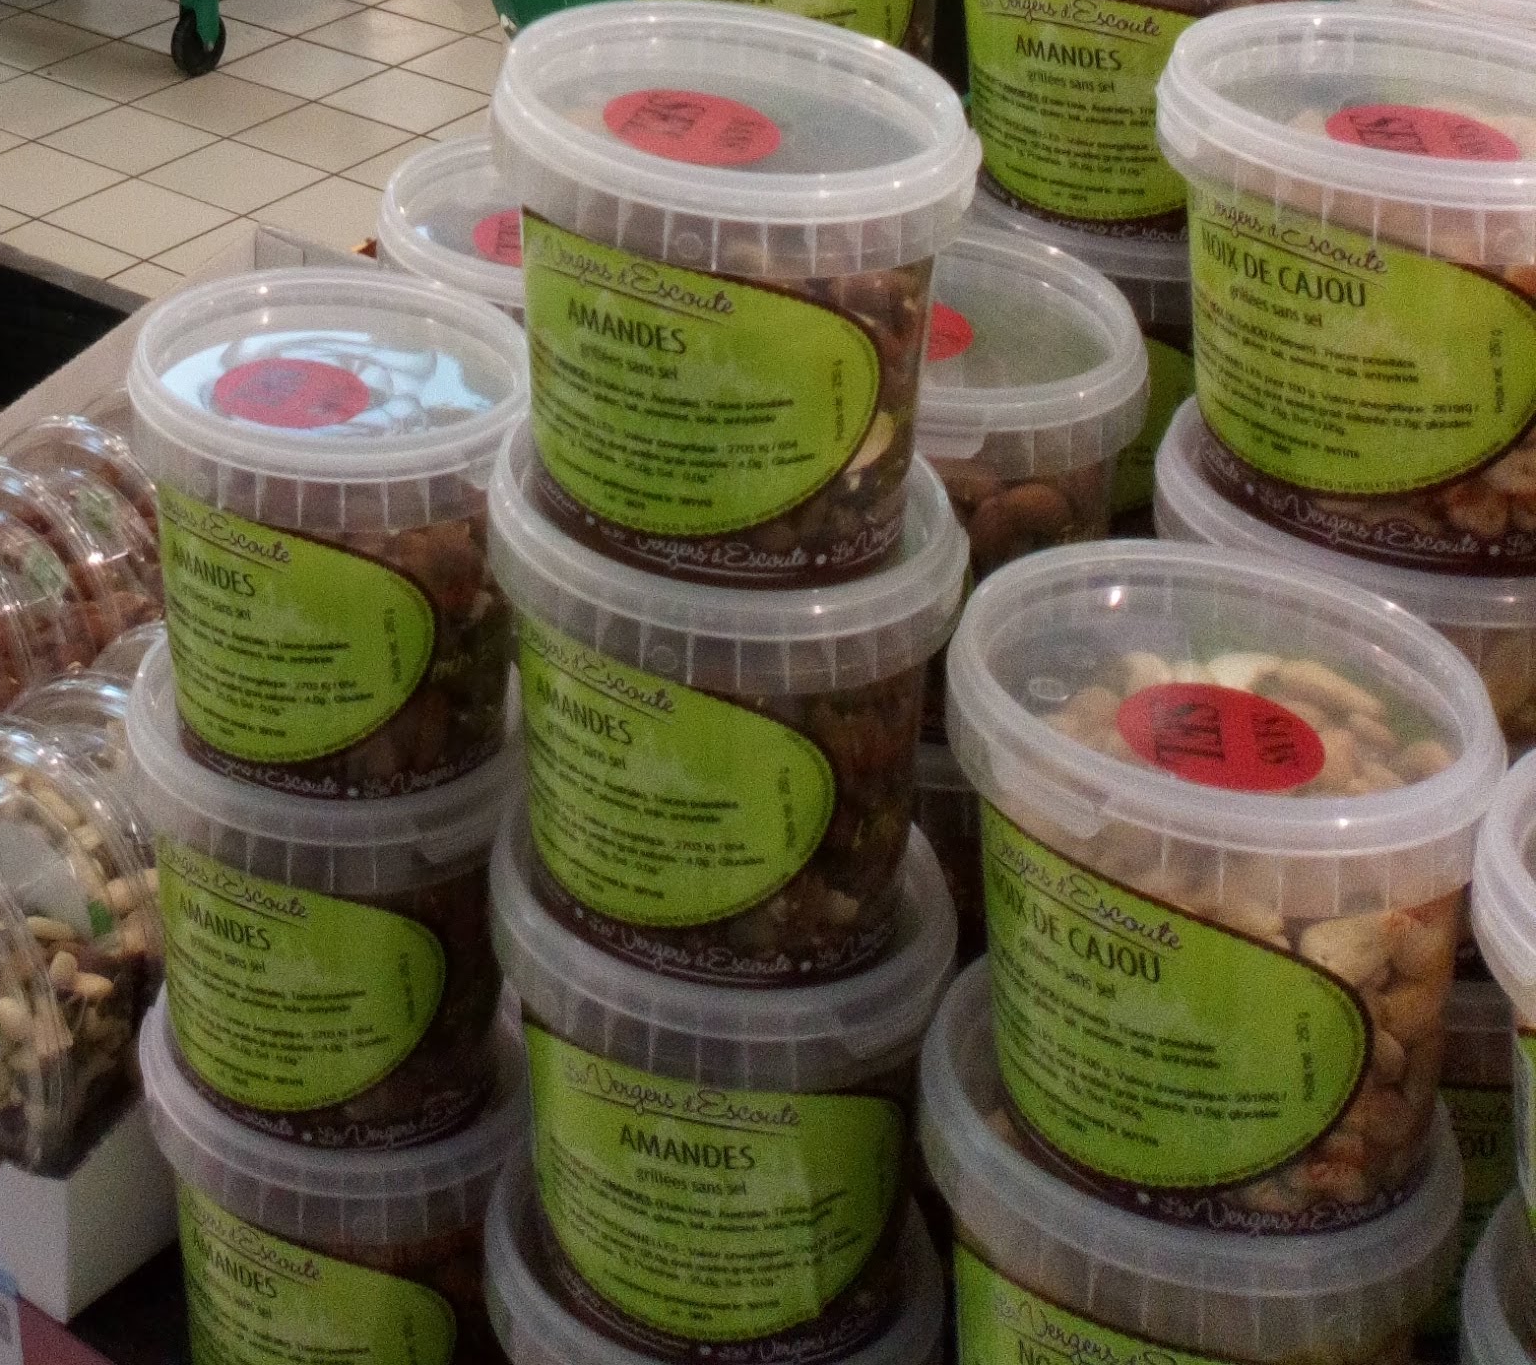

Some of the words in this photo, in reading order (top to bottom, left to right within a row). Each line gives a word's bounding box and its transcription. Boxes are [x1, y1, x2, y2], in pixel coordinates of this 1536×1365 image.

[1015, 33, 1123, 71] AMANDES
[1069, 74, 1094, 91] sans
[1097, 78, 1116, 93] sel
[1202, 224, 1239, 274] NOIX
[1243, 255, 1270, 287] DE
[1277, 267, 1366, 309] CAJOU
[567, 297, 688, 355] AMANDES
[172, 540, 256, 598] AMANDES
[535, 674, 634, 746] AMANDES
[179, 892, 271, 952] AMANDES
[1031, 906, 1064, 947] DE
[1068, 920, 1163, 984] CAJOU
[618, 1123, 756, 1170] AMANDES
